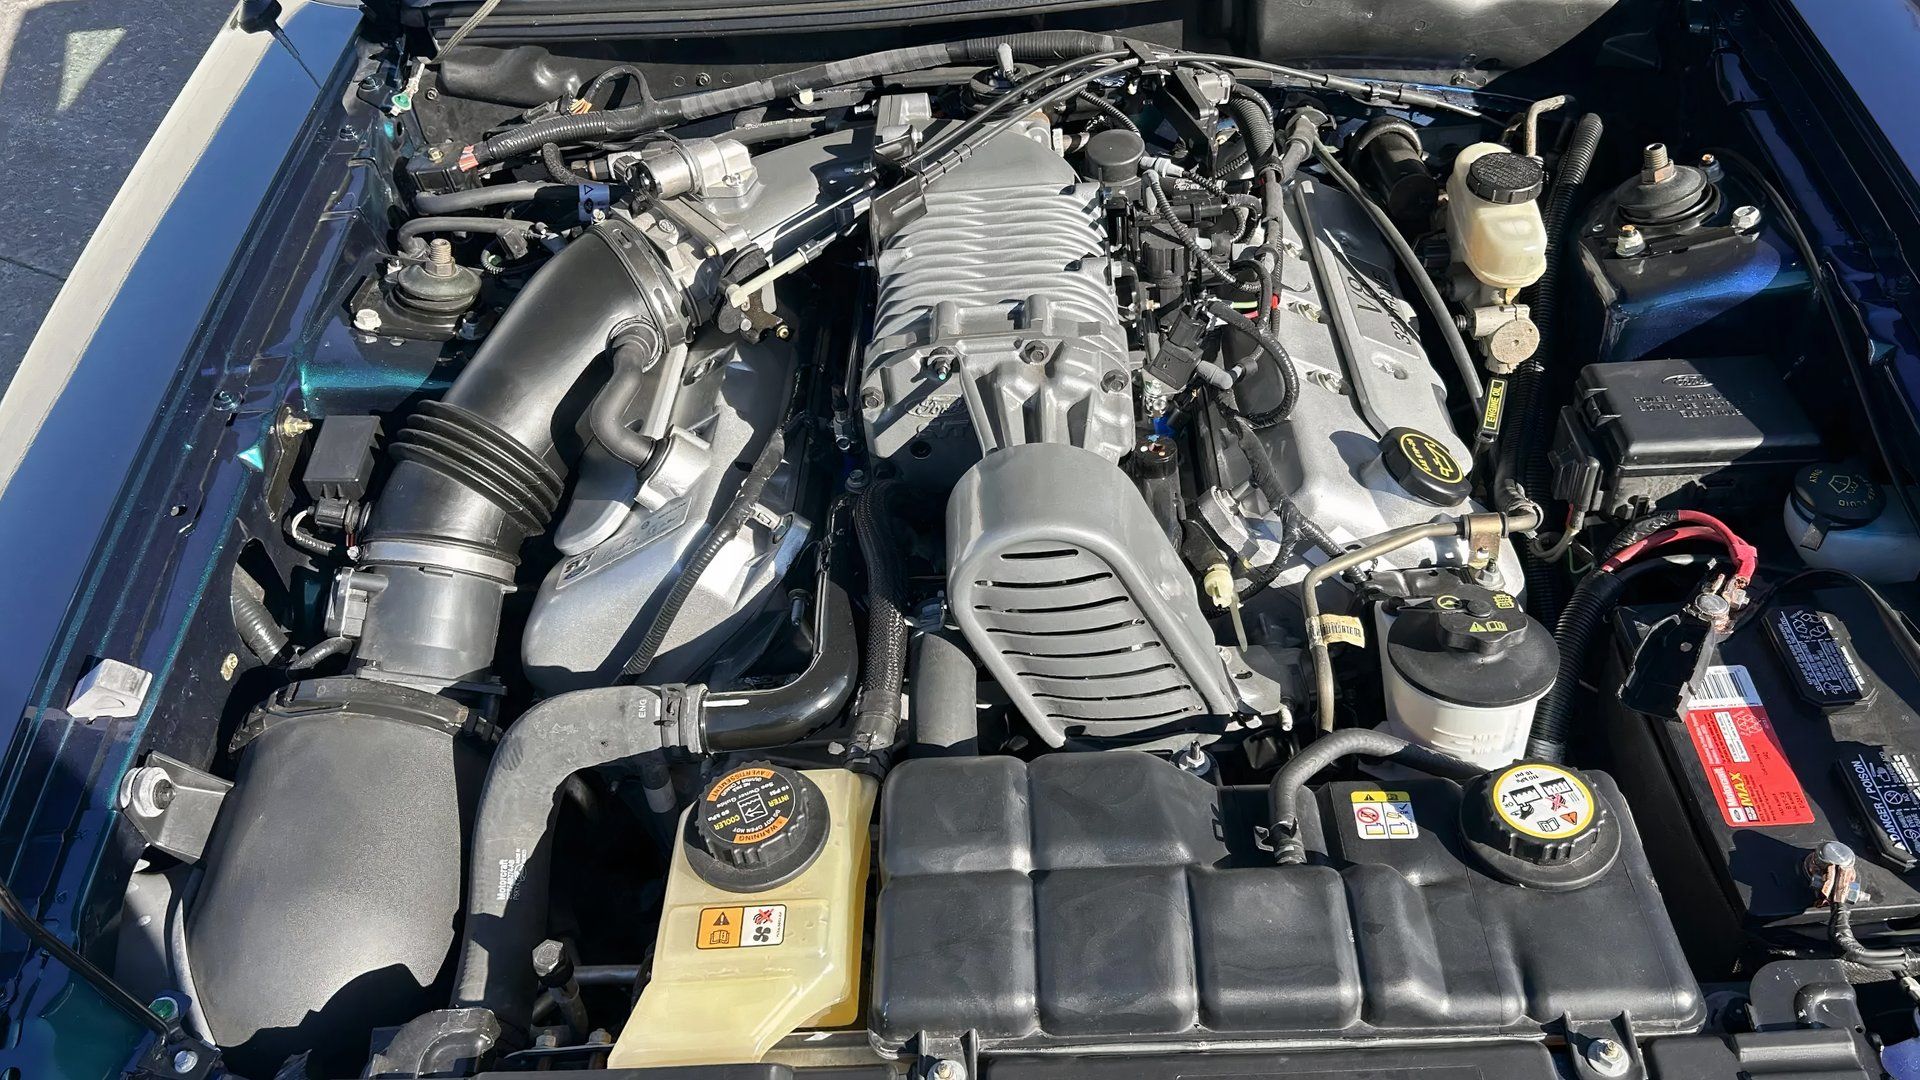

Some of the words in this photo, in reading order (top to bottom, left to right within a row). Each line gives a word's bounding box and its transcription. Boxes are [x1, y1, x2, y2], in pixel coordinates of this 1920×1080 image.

[1491, 384, 1501, 396] OIL
[1486, 396, 1499, 422] ENGINE
[638, 699, 646, 717] ENG
[711, 769, 766, 798] AVERTISSEMENT
[1850, 759, 1875, 793] POISON
[738, 788, 761, 800] Owner
[1712, 766, 1738, 806] Motorcraft
[1728, 771, 1753, 806] MAX
[716, 796, 737, 808] Guide
[767, 794, 790, 807] INTER
[713, 814, 740, 831] COOLER
[748, 823, 764, 833] OPEN
[1872, 801, 1900, 840] DANGER
[739, 824, 778, 841] WARNING
[496, 858, 507, 900] Motorcraft
